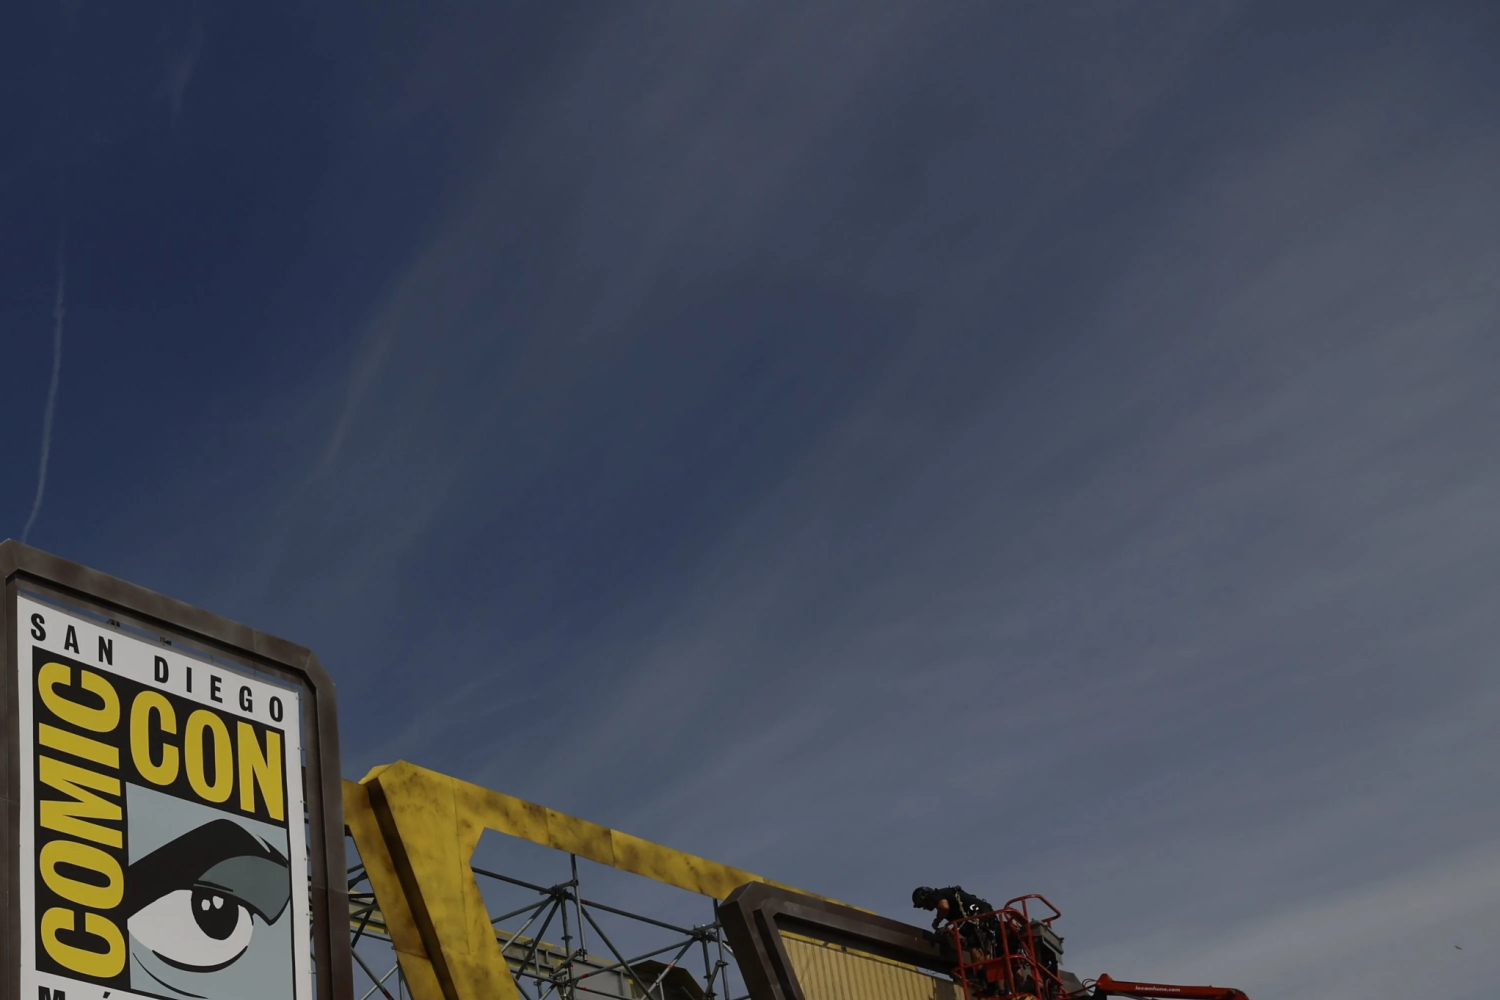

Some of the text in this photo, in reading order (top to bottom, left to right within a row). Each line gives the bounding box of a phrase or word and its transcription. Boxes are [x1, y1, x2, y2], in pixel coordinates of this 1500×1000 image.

[30, 613, 284, 722] SAN DIEGO
[37, 661, 126, 979] COMIC
[129, 690, 285, 822] CON
